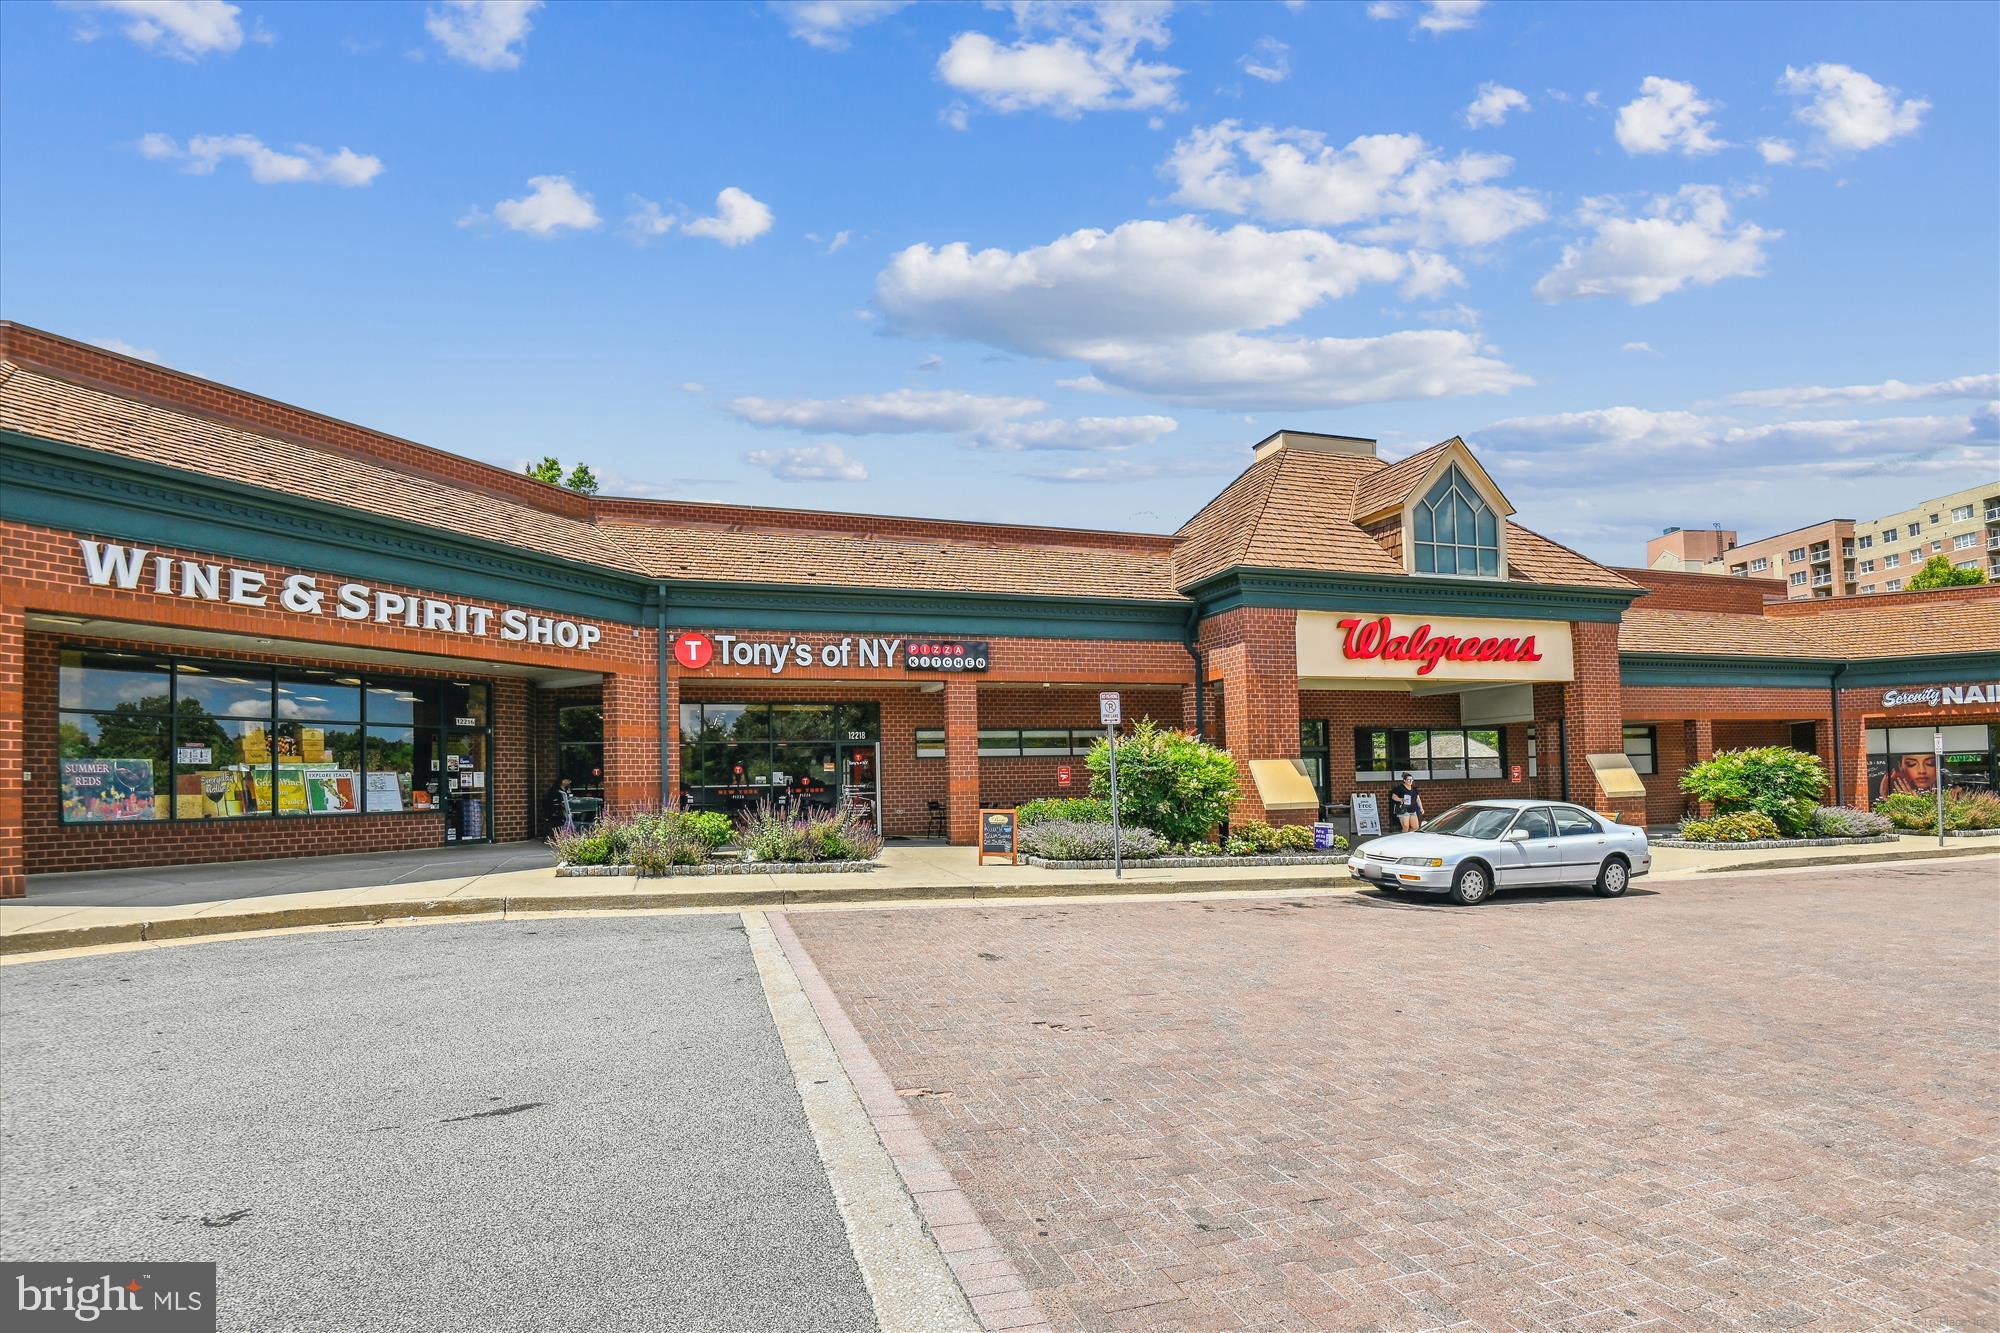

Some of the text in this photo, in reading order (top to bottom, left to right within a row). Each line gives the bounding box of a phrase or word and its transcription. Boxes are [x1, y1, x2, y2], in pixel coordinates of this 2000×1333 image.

[78, 539, 600, 650] WINE & SPIRIT SHOP
[909, 644, 963, 655] PIZZA
[1337, 616, 1543, 675] Walgreens
[684, 634, 900, 674] T Tony's of NY
[909, 657, 985, 668] KITCHEN
[1883, 688, 1940, 706] Serenity
[848, 731, 866, 740] 12218
[65, 763, 110, 773] SUMMER
[75, 776, 102, 786] REDS
